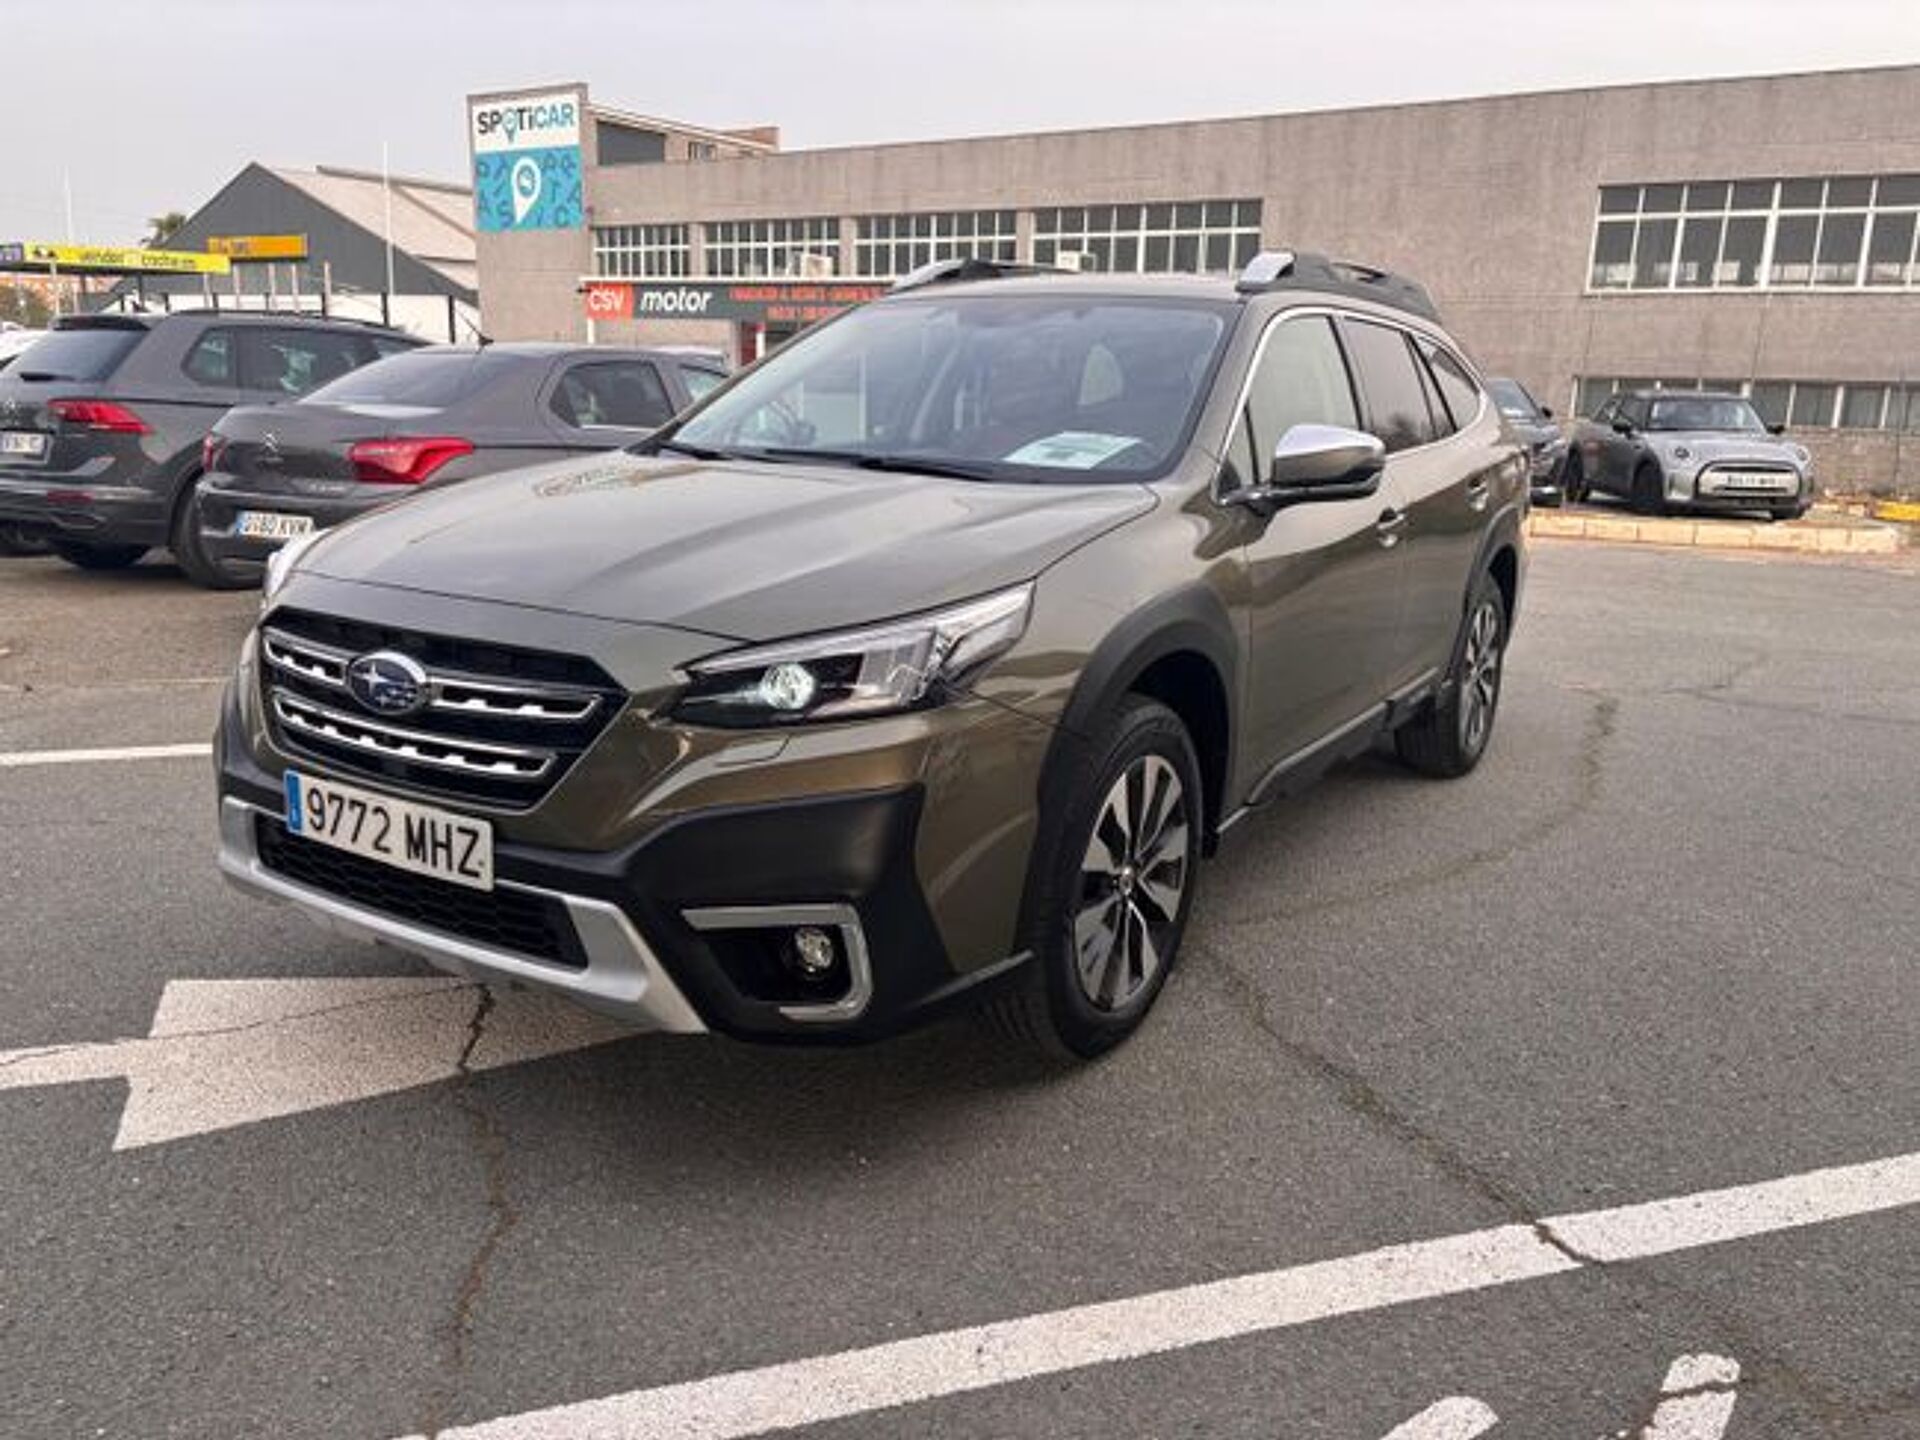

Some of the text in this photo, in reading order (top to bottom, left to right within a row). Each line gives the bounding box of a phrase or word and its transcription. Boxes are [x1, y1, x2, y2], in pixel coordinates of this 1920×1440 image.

[640, 286, 713, 312] motor
[306, 787, 480, 879] 9772 MHZ
